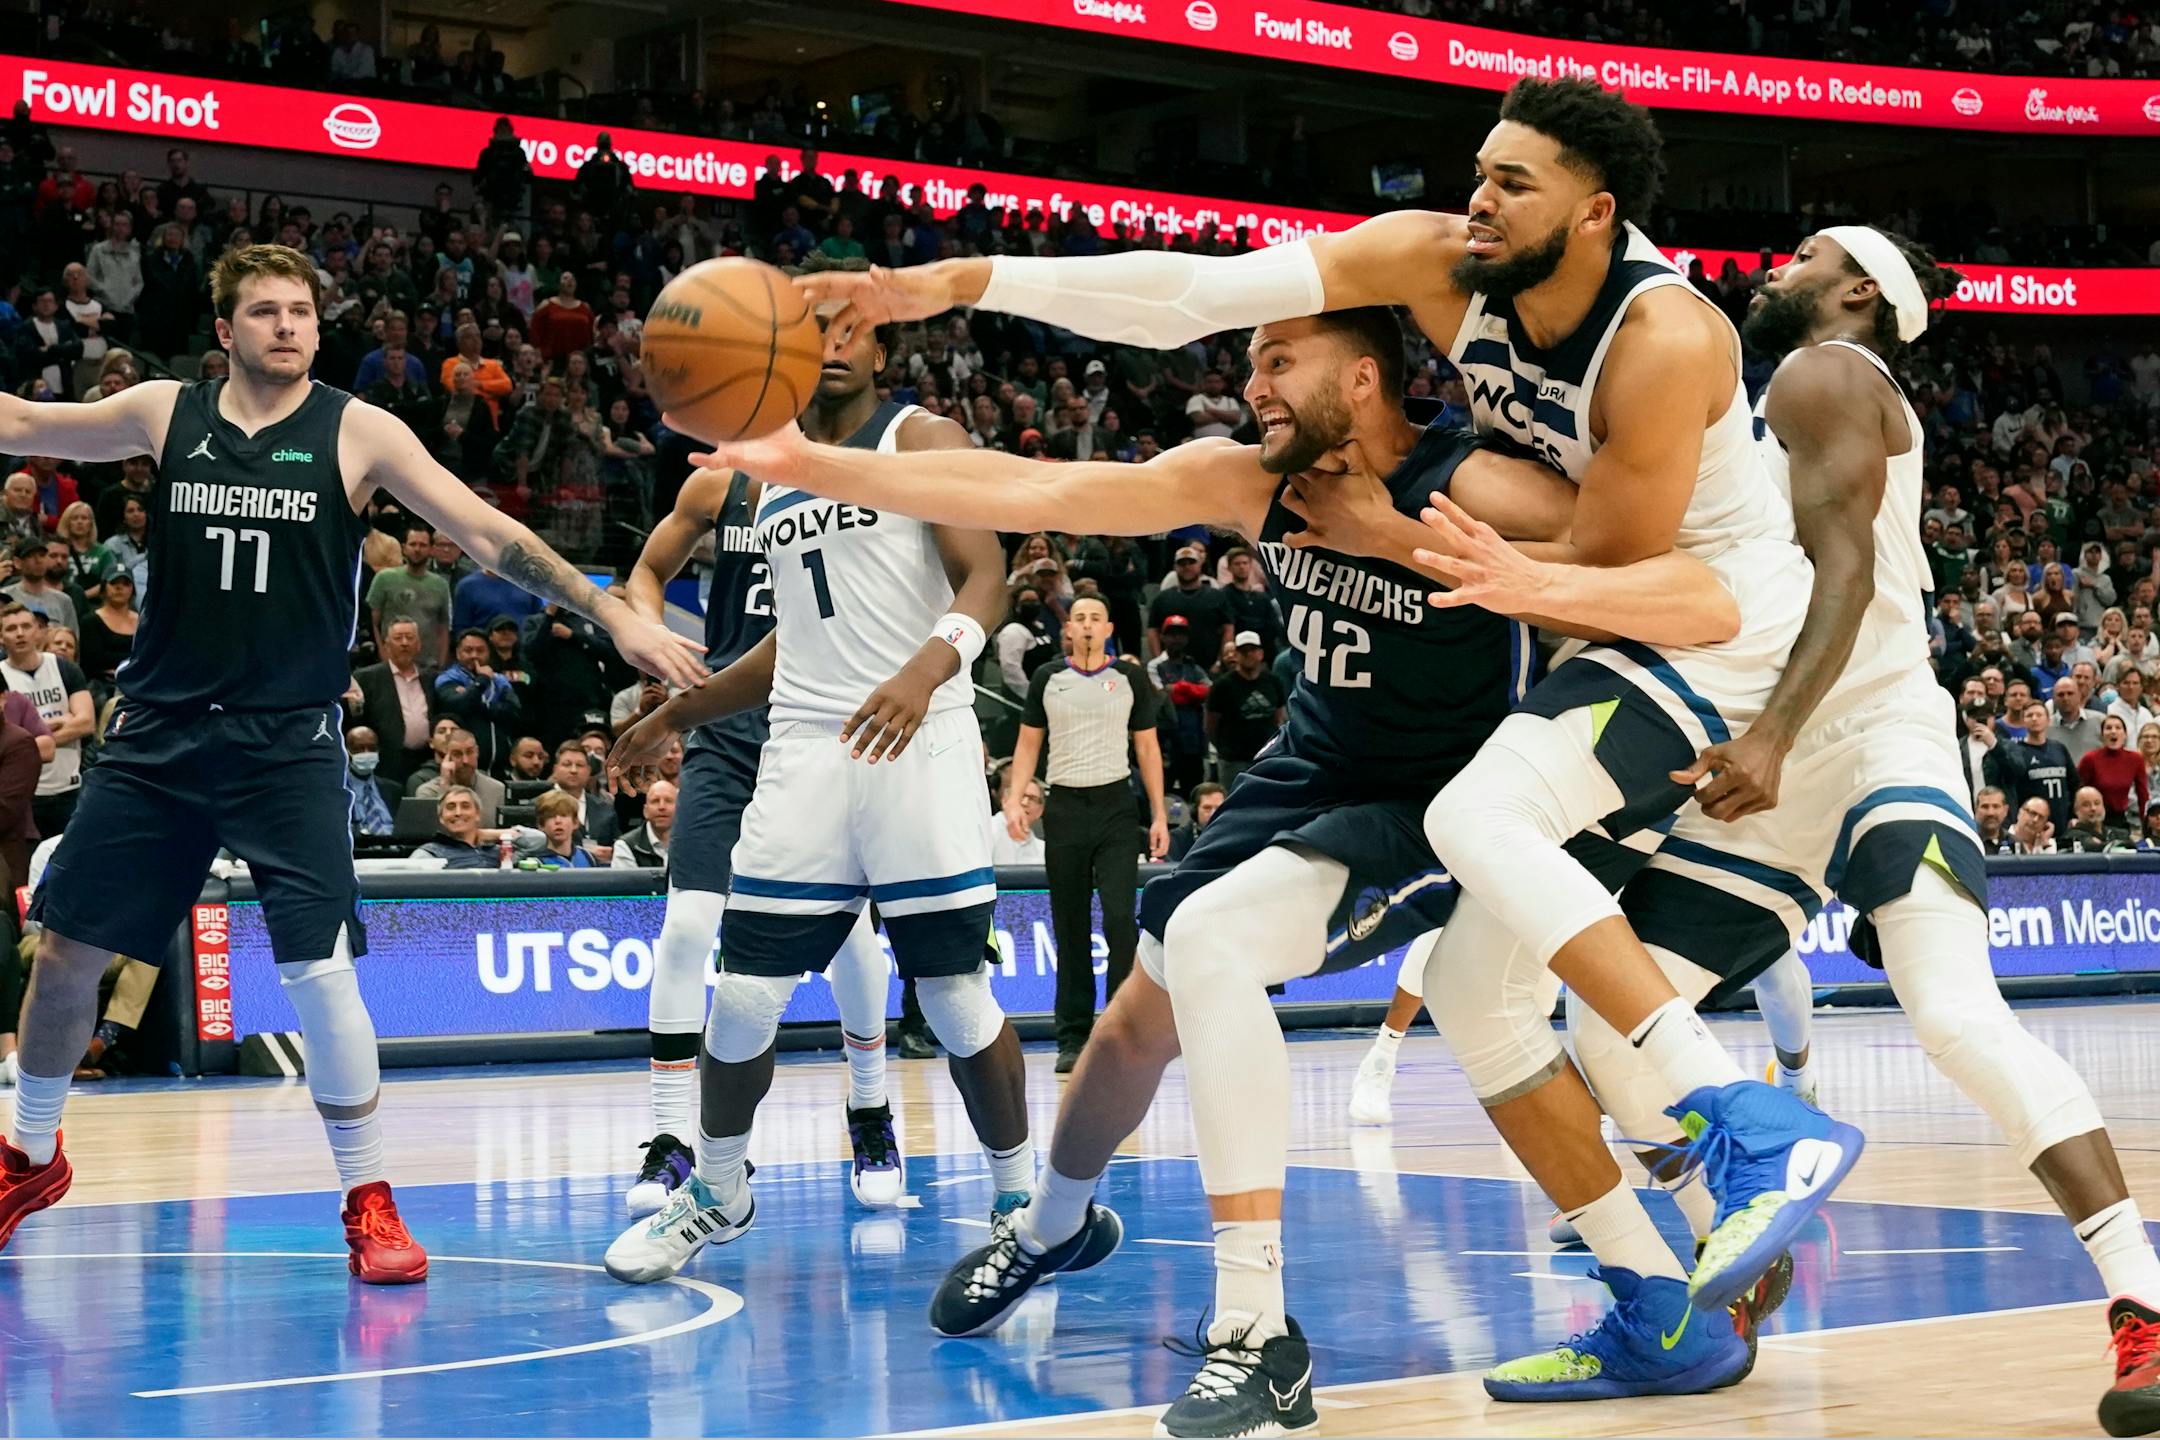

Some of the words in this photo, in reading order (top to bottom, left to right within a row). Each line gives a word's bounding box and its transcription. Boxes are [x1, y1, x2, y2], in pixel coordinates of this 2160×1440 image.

[1254, 12, 1302, 42] Fowl
[1306, 19, 1353, 50] Shot
[1448, 39, 1552, 79] Download
[1557, 56, 1597, 82] the
[1601, 60, 1740, 96] Chick-Fil-A
[1744, 72, 1792, 104] App
[1795, 76, 1823, 101] to
[1828, 78, 1922, 109] Redeem
[22, 69, 116, 118] Fowl
[127, 81, 220, 130] Shot
[565, 144, 748, 187] csecutive
[924, 179, 1019, 214] thrws
[1956, 274, 2003, 304] owl
[2010, 275, 2077, 306] Shot
[271, 448, 314, 463] chime
[169, 481, 319, 523] MAVERICKS
[757, 503, 879, 553] WOLVES
[205, 526, 271, 593] 77
[744, 562, 778, 617] 2
[801, 548, 836, 619] 1
[1258, 541, 1424, 625] MAVERICKS
[1286, 604, 1372, 688] 42
[2042, 778, 2063, 799] 77
[196, 907, 228, 922] BIO
[198, 953, 229, 968] BIO
[476, 929, 664, 994] UTSo
[200, 998, 232, 1013] BIO
